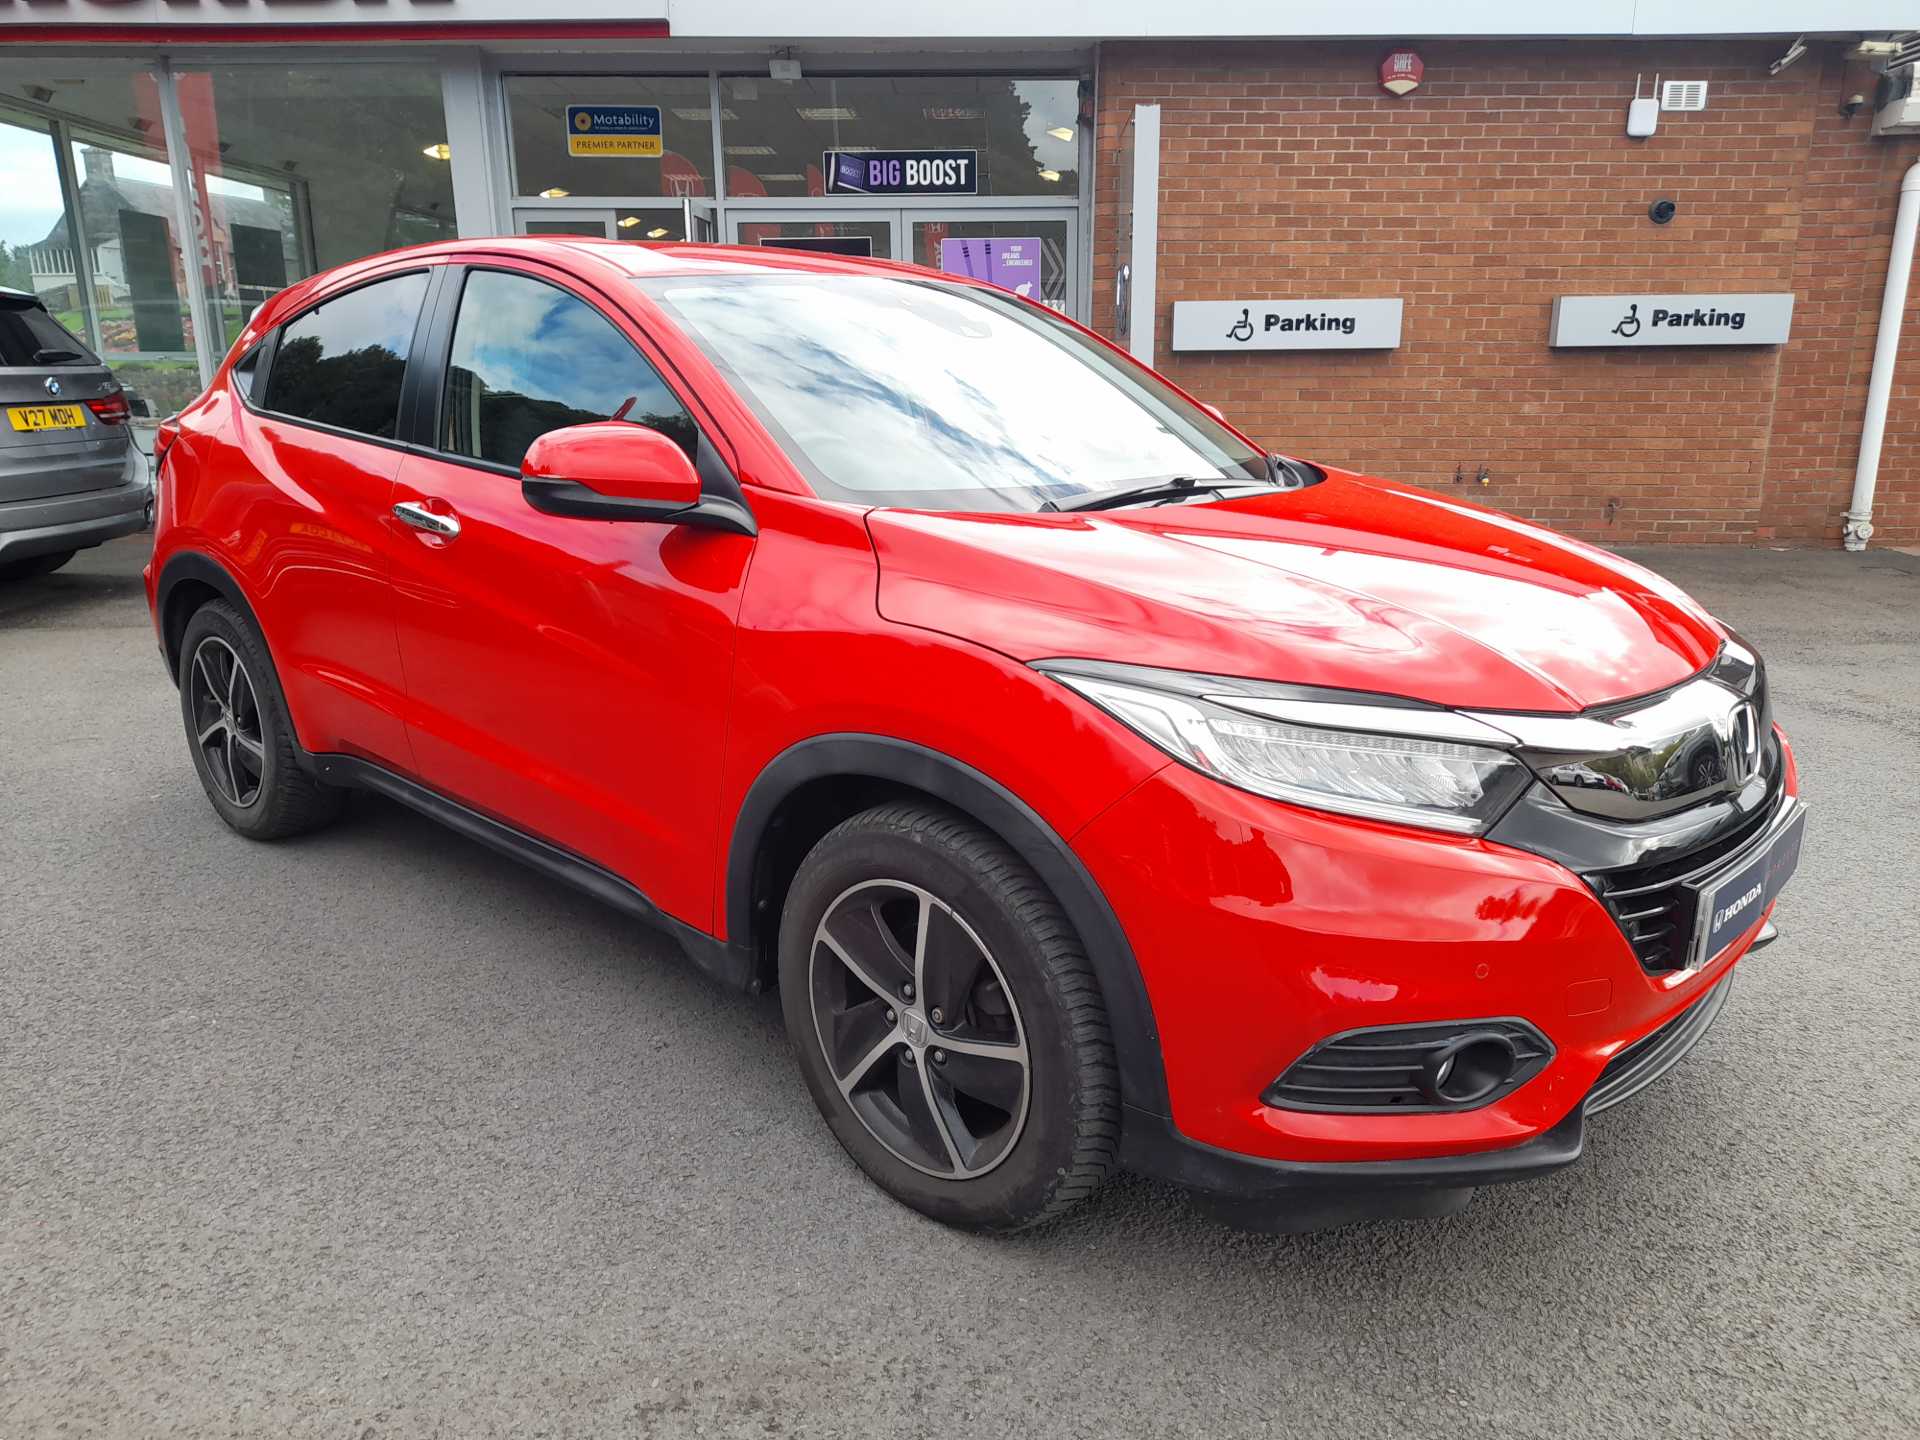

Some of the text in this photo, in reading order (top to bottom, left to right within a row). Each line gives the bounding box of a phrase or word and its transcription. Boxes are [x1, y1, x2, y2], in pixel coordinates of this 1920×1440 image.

[593, 113, 655, 129] Motability
[576, 141, 656, 150] PREMIER PARTNER
[869, 158, 969, 186] BIG BOOST
[1264, 313, 1356, 335] Parking
[1651, 308, 1746, 330] Parking
[18, 407, 76, 427] V27 MDH
[1723, 882, 1763, 923] HONDA
